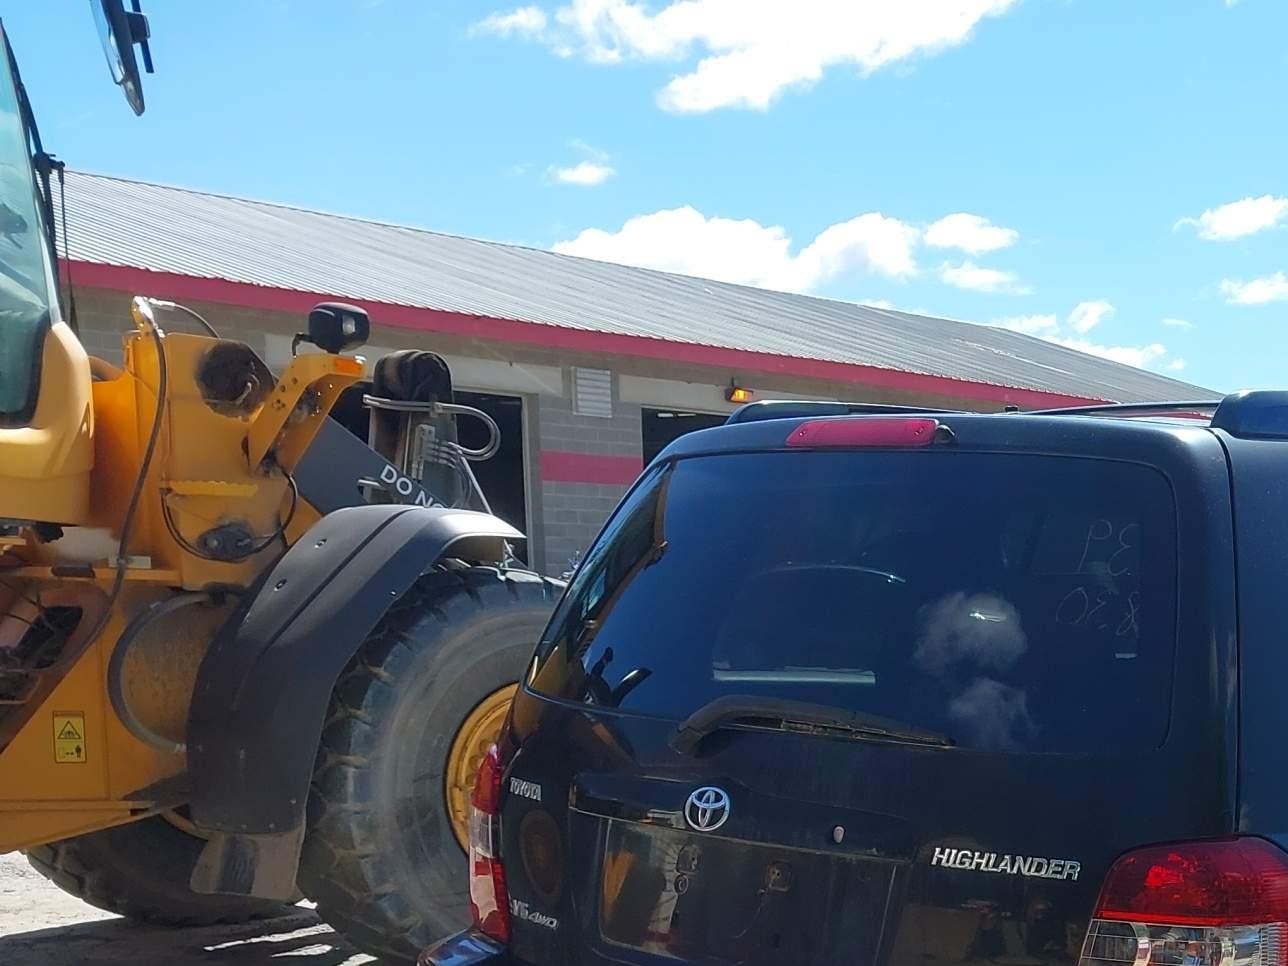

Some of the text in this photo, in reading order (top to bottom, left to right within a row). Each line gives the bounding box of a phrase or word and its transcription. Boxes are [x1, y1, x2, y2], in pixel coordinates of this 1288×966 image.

[380, 464, 412, 495] DO
[510, 776, 542, 801] TOYOTA
[931, 847, 1082, 881] HIGHLANDER
[512, 899, 558, 930] V6 4WD
